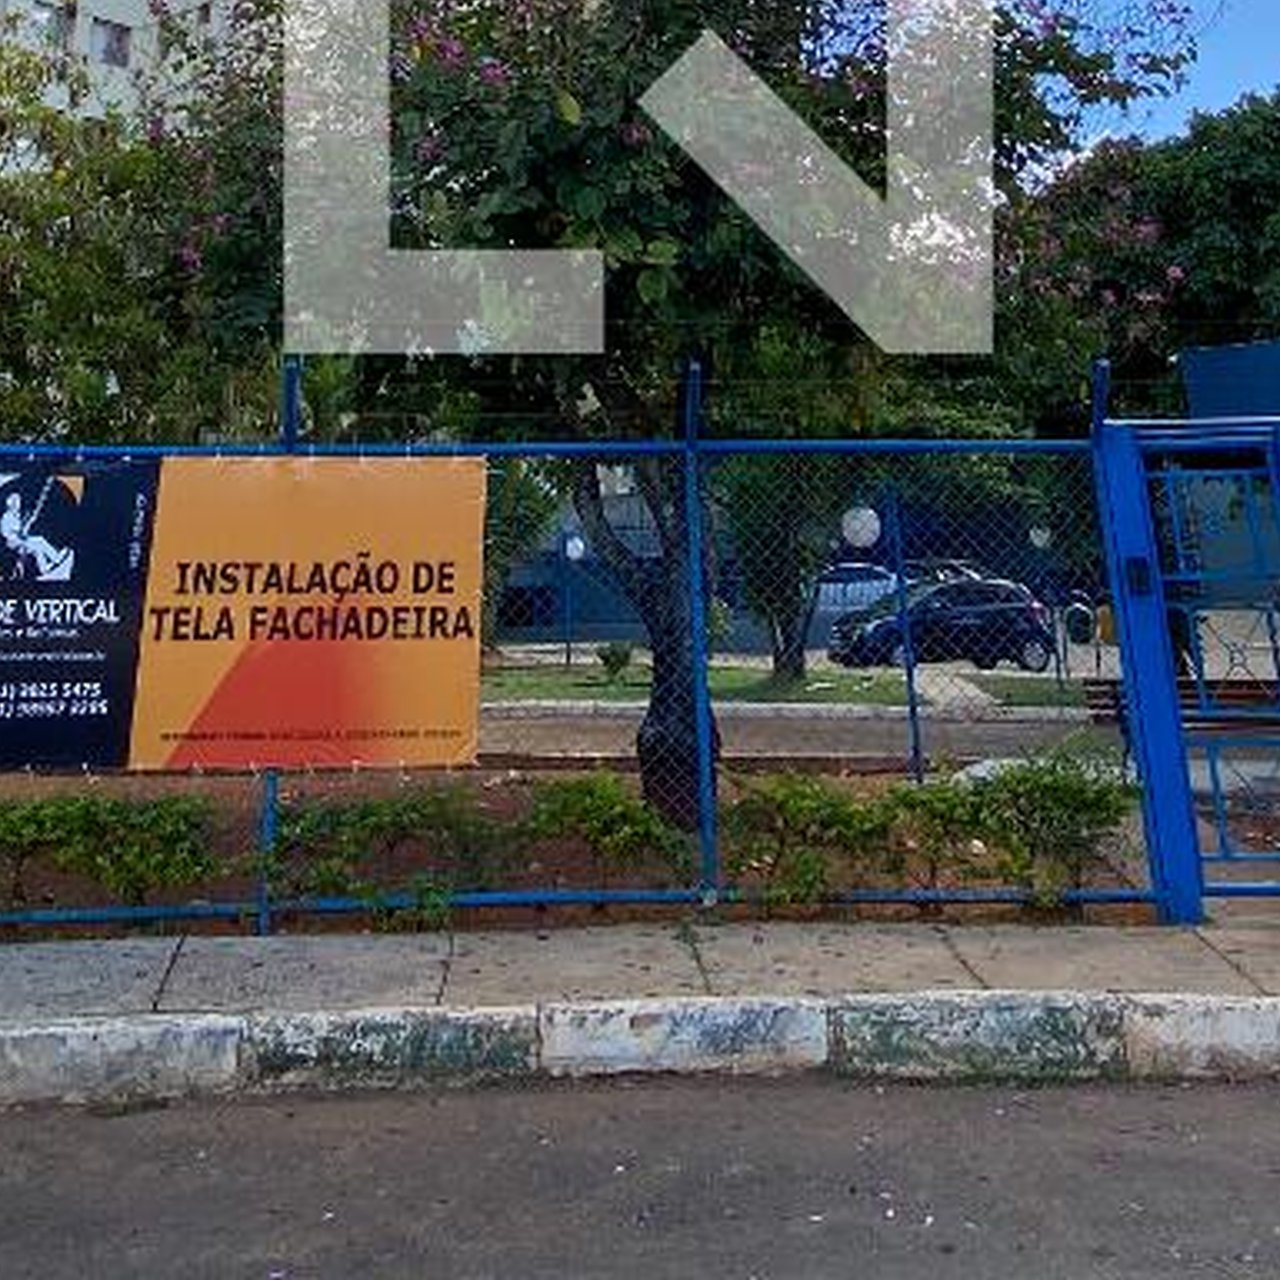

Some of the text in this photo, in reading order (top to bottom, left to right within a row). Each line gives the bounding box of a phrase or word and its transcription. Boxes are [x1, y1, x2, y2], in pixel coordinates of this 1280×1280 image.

[175, 552, 455, 603] INSTALAÇÃO DE
[24, 599, 120, 624] VERTICAL
[149, 606, 475, 642] TELA FACHADEIRA
